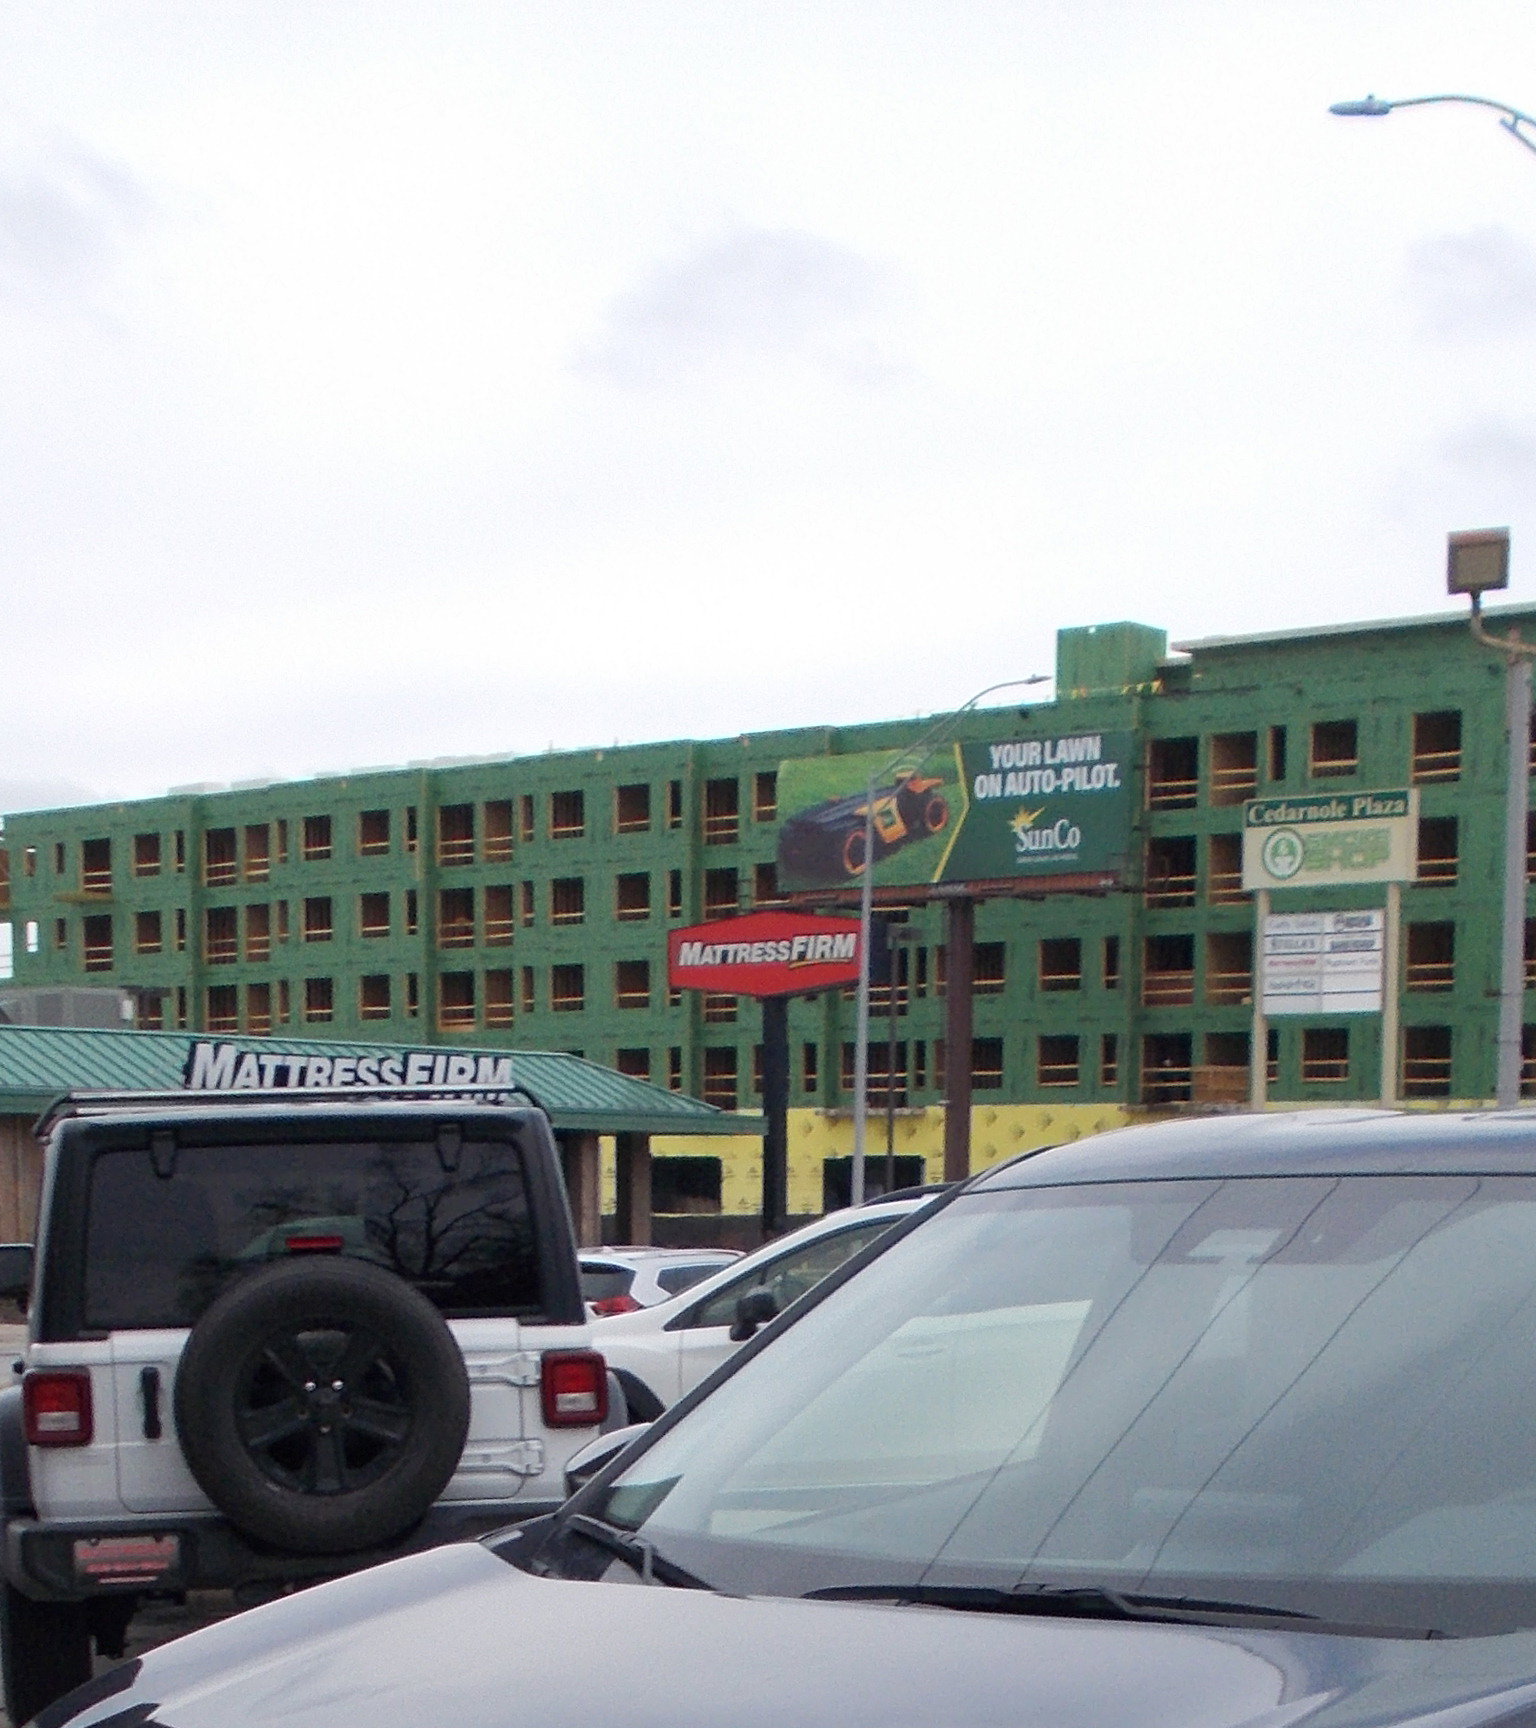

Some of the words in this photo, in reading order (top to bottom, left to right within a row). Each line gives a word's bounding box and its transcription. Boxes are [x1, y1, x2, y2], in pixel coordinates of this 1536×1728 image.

[989, 740, 1043, 769] YOUR
[1044, 735, 1101, 765] LAWN
[974, 773, 1002, 799] ON
[1004, 763, 1121, 797] AUTO-PILOT.
[1249, 800, 1348, 824] Cedarnole
[1352, 796, 1406, 816] Plaza
[1016, 818, 1081, 852] SunCo
